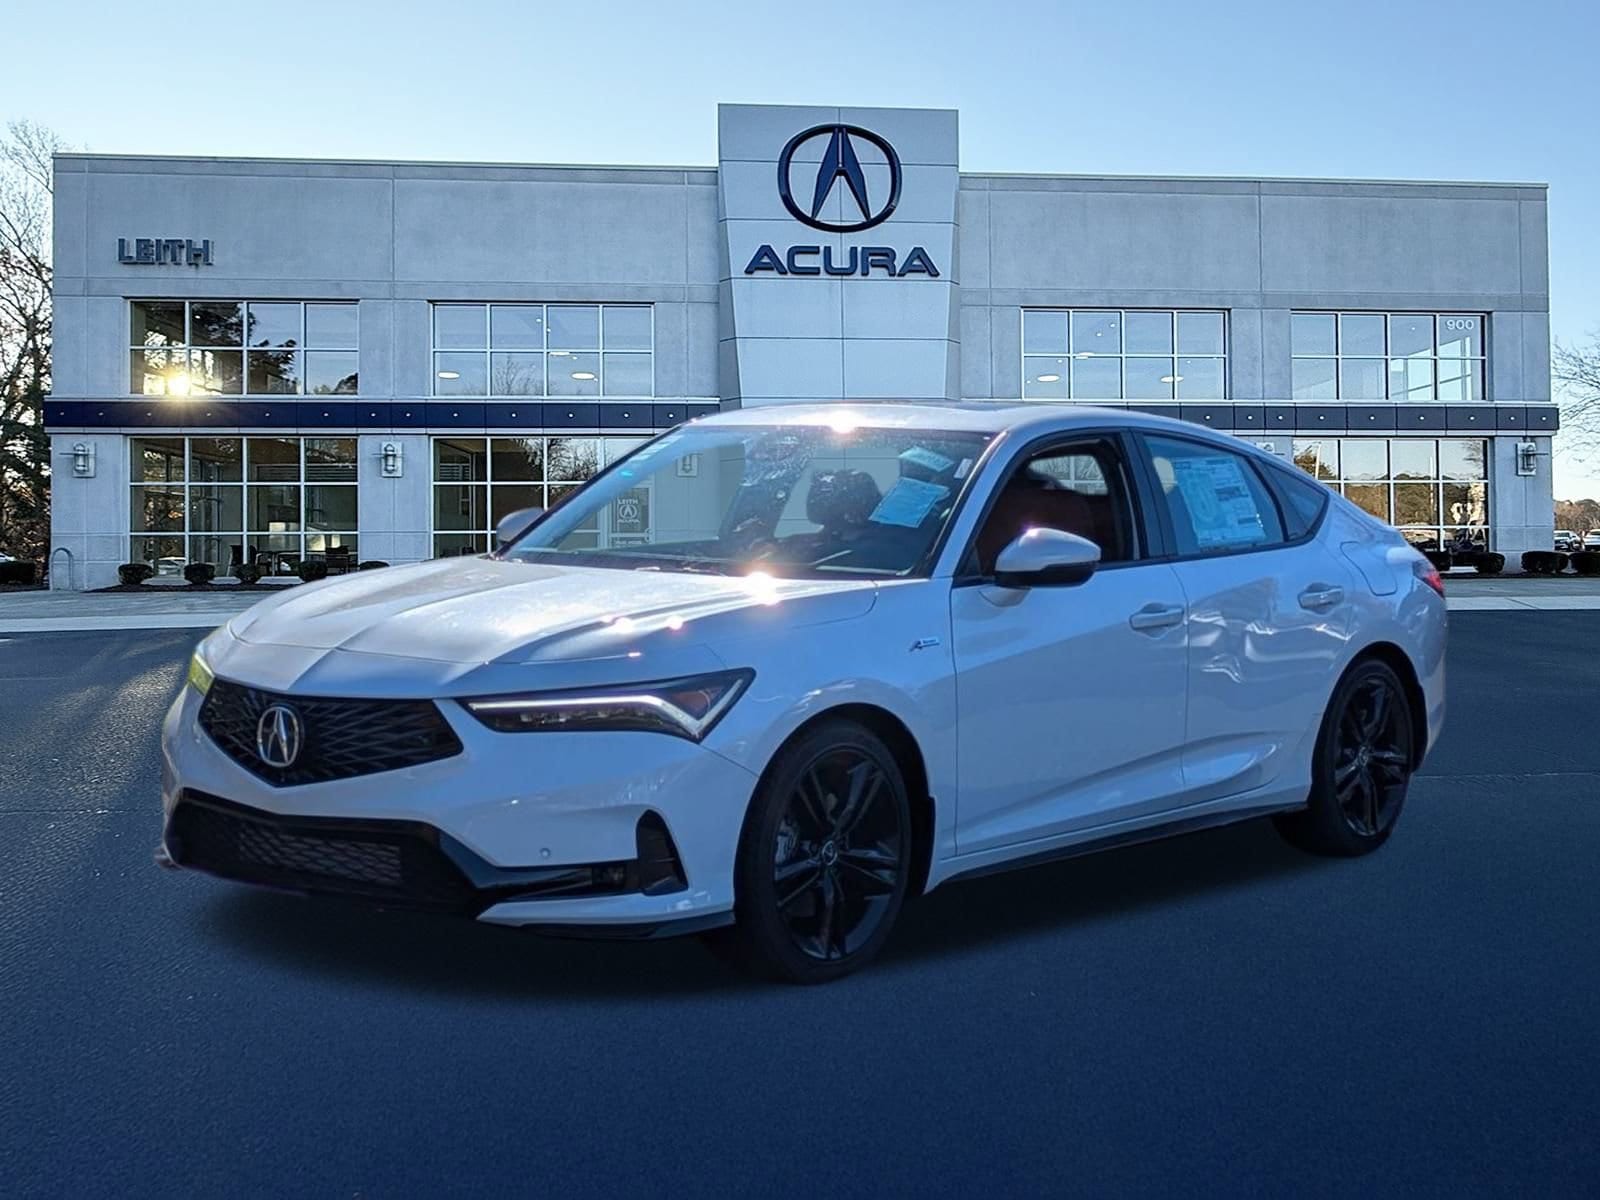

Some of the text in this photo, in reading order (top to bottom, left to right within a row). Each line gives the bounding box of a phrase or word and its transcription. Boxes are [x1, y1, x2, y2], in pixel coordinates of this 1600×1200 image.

[118, 238, 213, 264] LEITH
[744, 244, 940, 277] ACURA
[1446, 319, 1474, 330] 900
